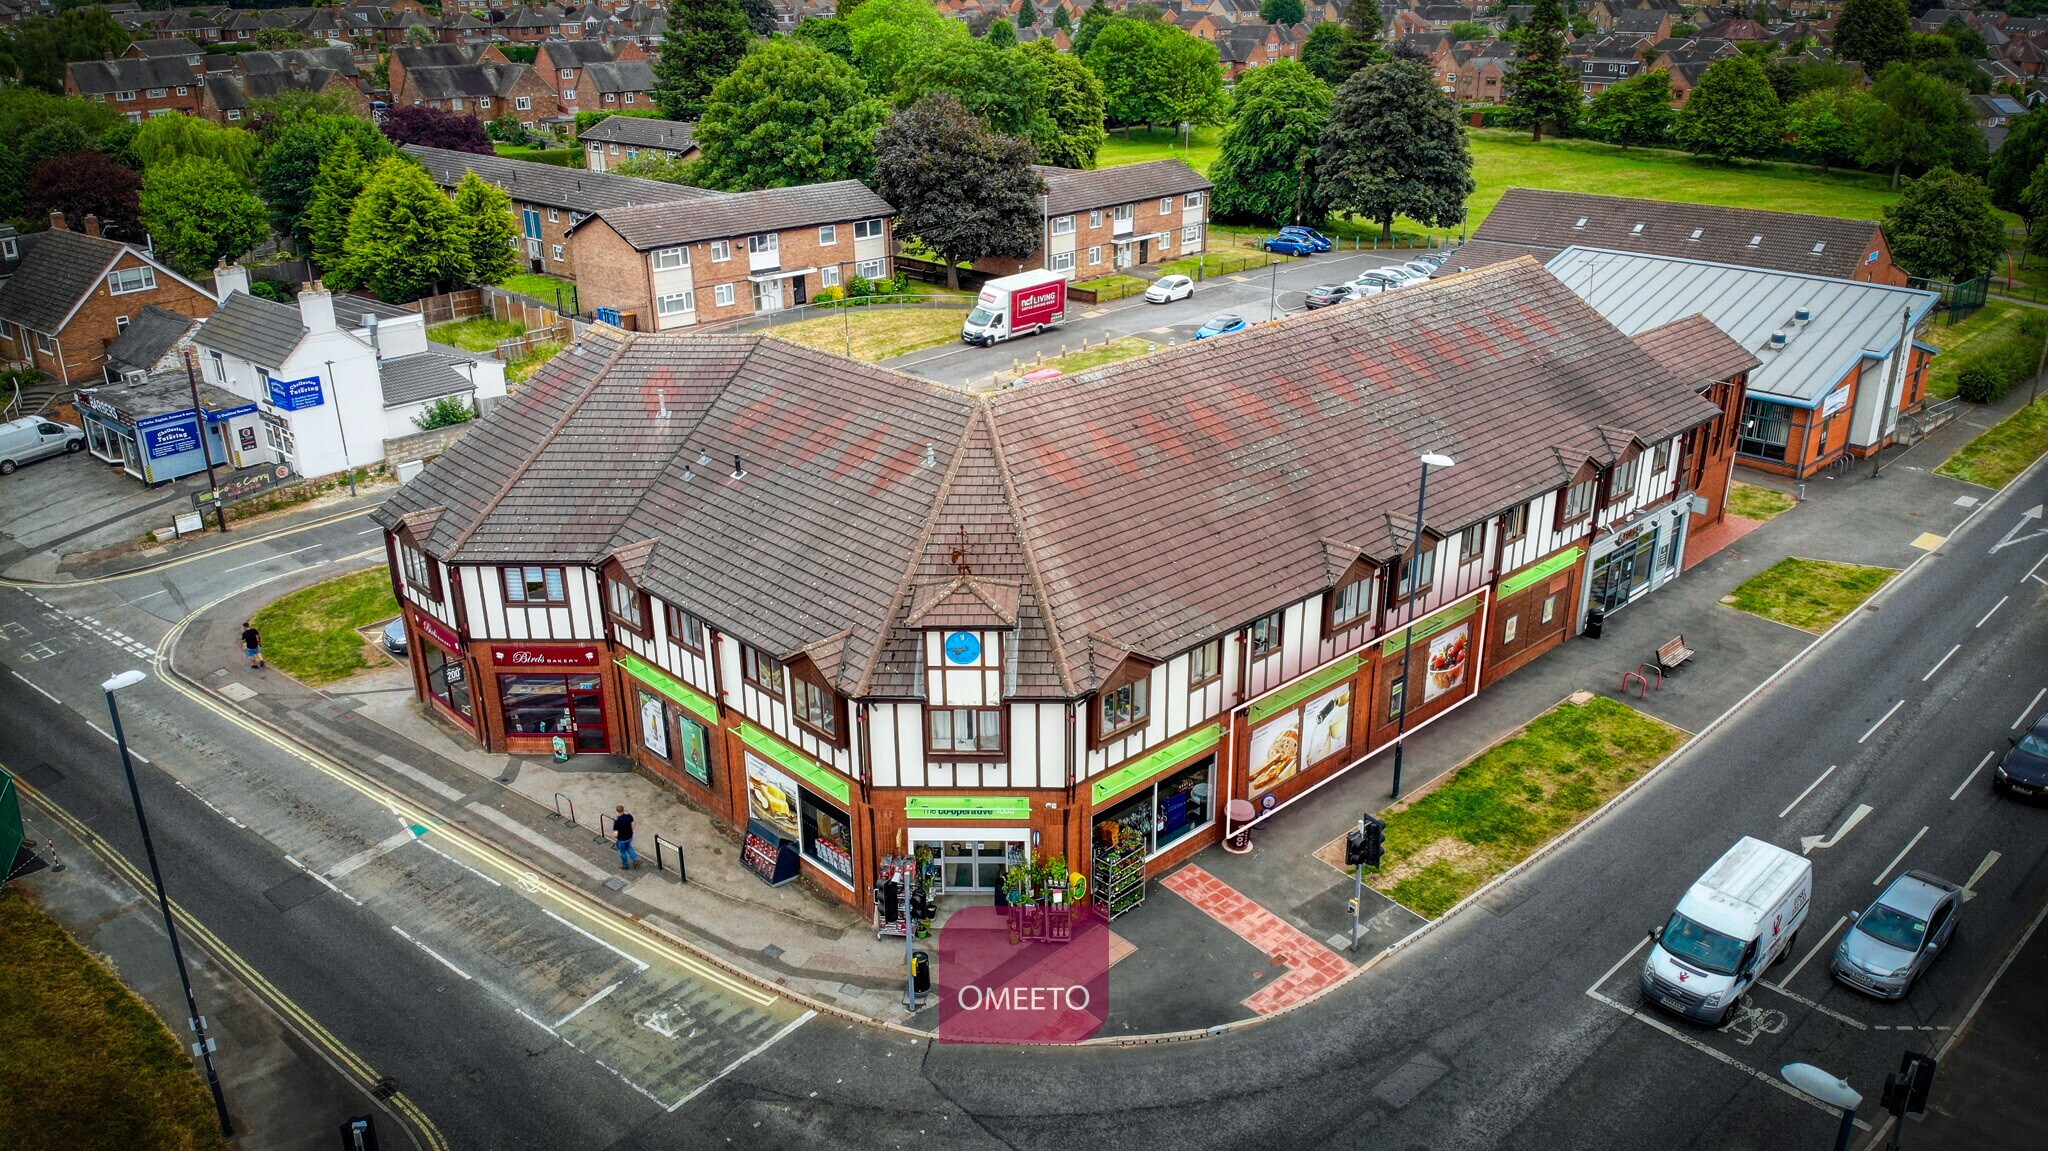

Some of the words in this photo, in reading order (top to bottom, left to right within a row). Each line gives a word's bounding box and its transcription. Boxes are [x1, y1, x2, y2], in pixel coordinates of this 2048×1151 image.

[1021, 295, 1033, 307] ncf
[1033, 292, 1055, 304] LIVING
[289, 386, 319, 395] Tutoring
[157, 432, 188, 442] Tutoring
[243, 473, 270, 486] Curry
[512, 651, 545, 663] Birds
[447, 670, 460, 680] 200
